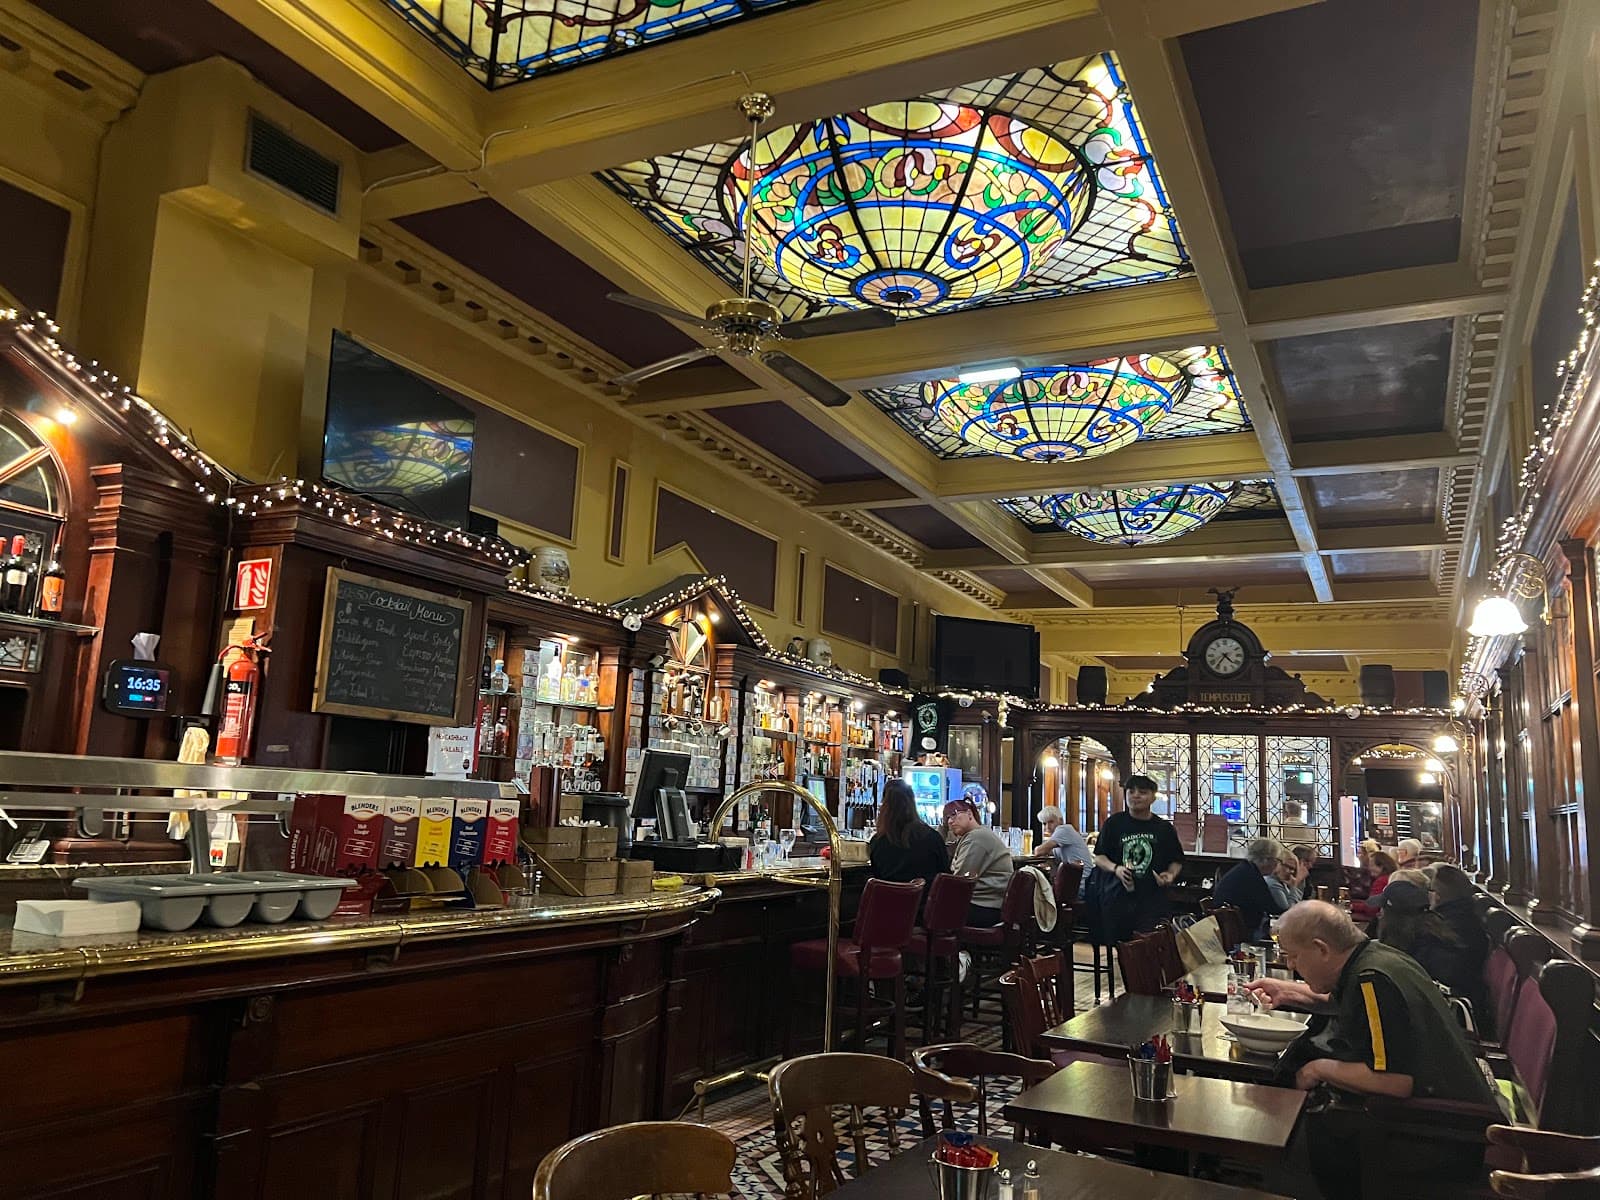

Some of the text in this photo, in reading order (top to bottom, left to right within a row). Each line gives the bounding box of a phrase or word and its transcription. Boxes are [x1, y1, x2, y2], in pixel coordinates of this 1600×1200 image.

[368, 590, 411, 612] Cocktail
[409, 604, 447, 621] Menu
[127, 676, 161, 692] 16:35
[351, 803, 379, 811] BLENDERS
[390, 806, 416, 814] BLENDERS
[426, 806, 449, 815] BLENDERS
[460, 806, 482, 814] BLENDERS
[494, 807, 516, 815] BLENDERS
[290, 829, 301, 870] BLENDERS
